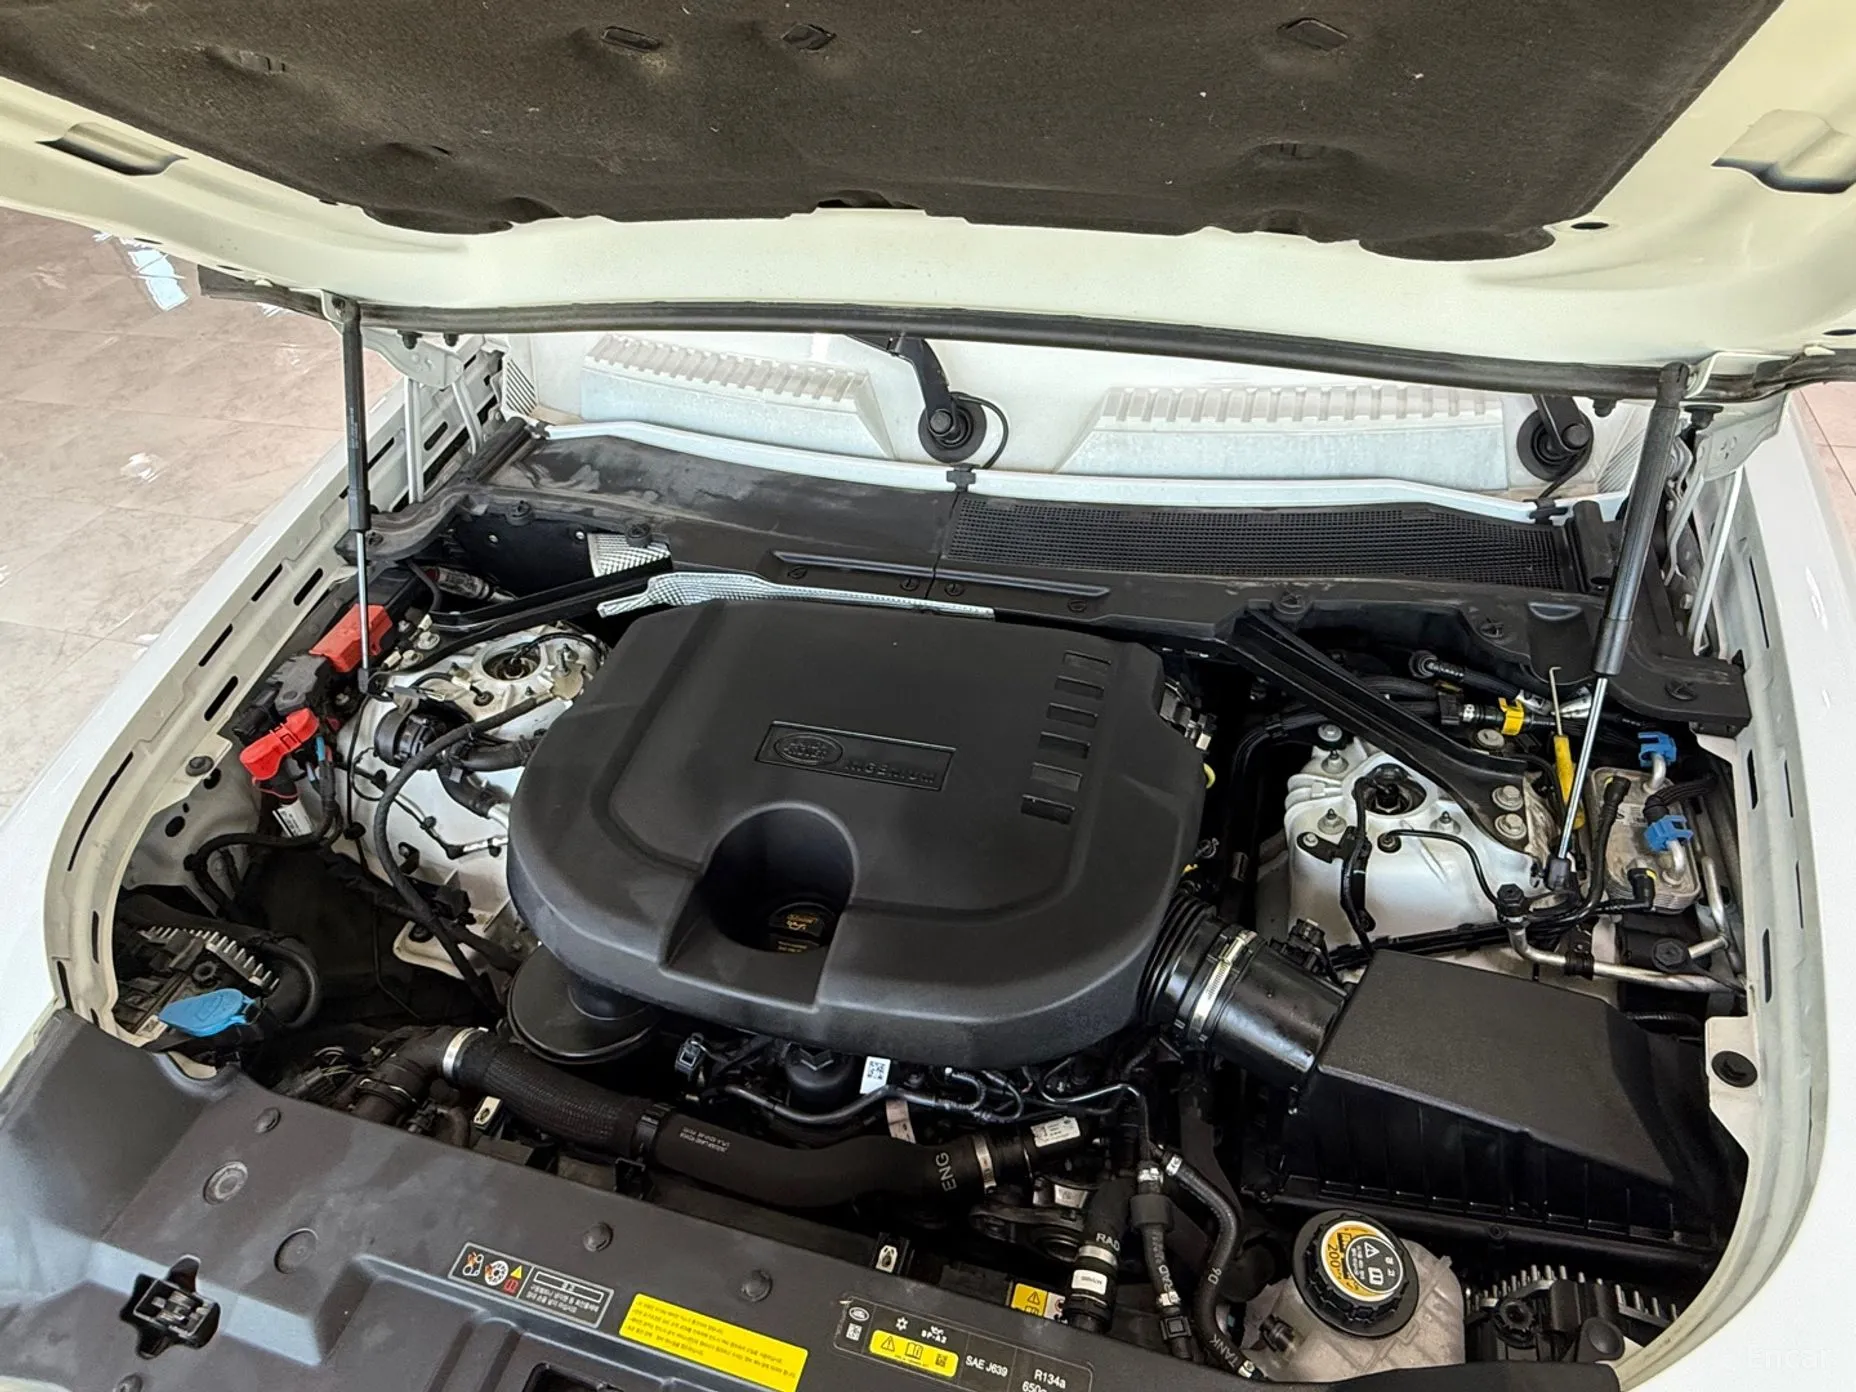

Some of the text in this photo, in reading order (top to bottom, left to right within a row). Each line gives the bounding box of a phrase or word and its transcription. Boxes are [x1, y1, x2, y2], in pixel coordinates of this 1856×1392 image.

[935, 1150, 958, 1192] ENG
[1095, 1232, 1121, 1252] RAD
[1327, 1243, 1340, 1269] 200
[1158, 1264, 1178, 1292] RAD
[1209, 1333, 1239, 1369] TANK
[965, 1355, 1009, 1378] SAE J639
[1034, 1369, 1066, 1390] R134a
